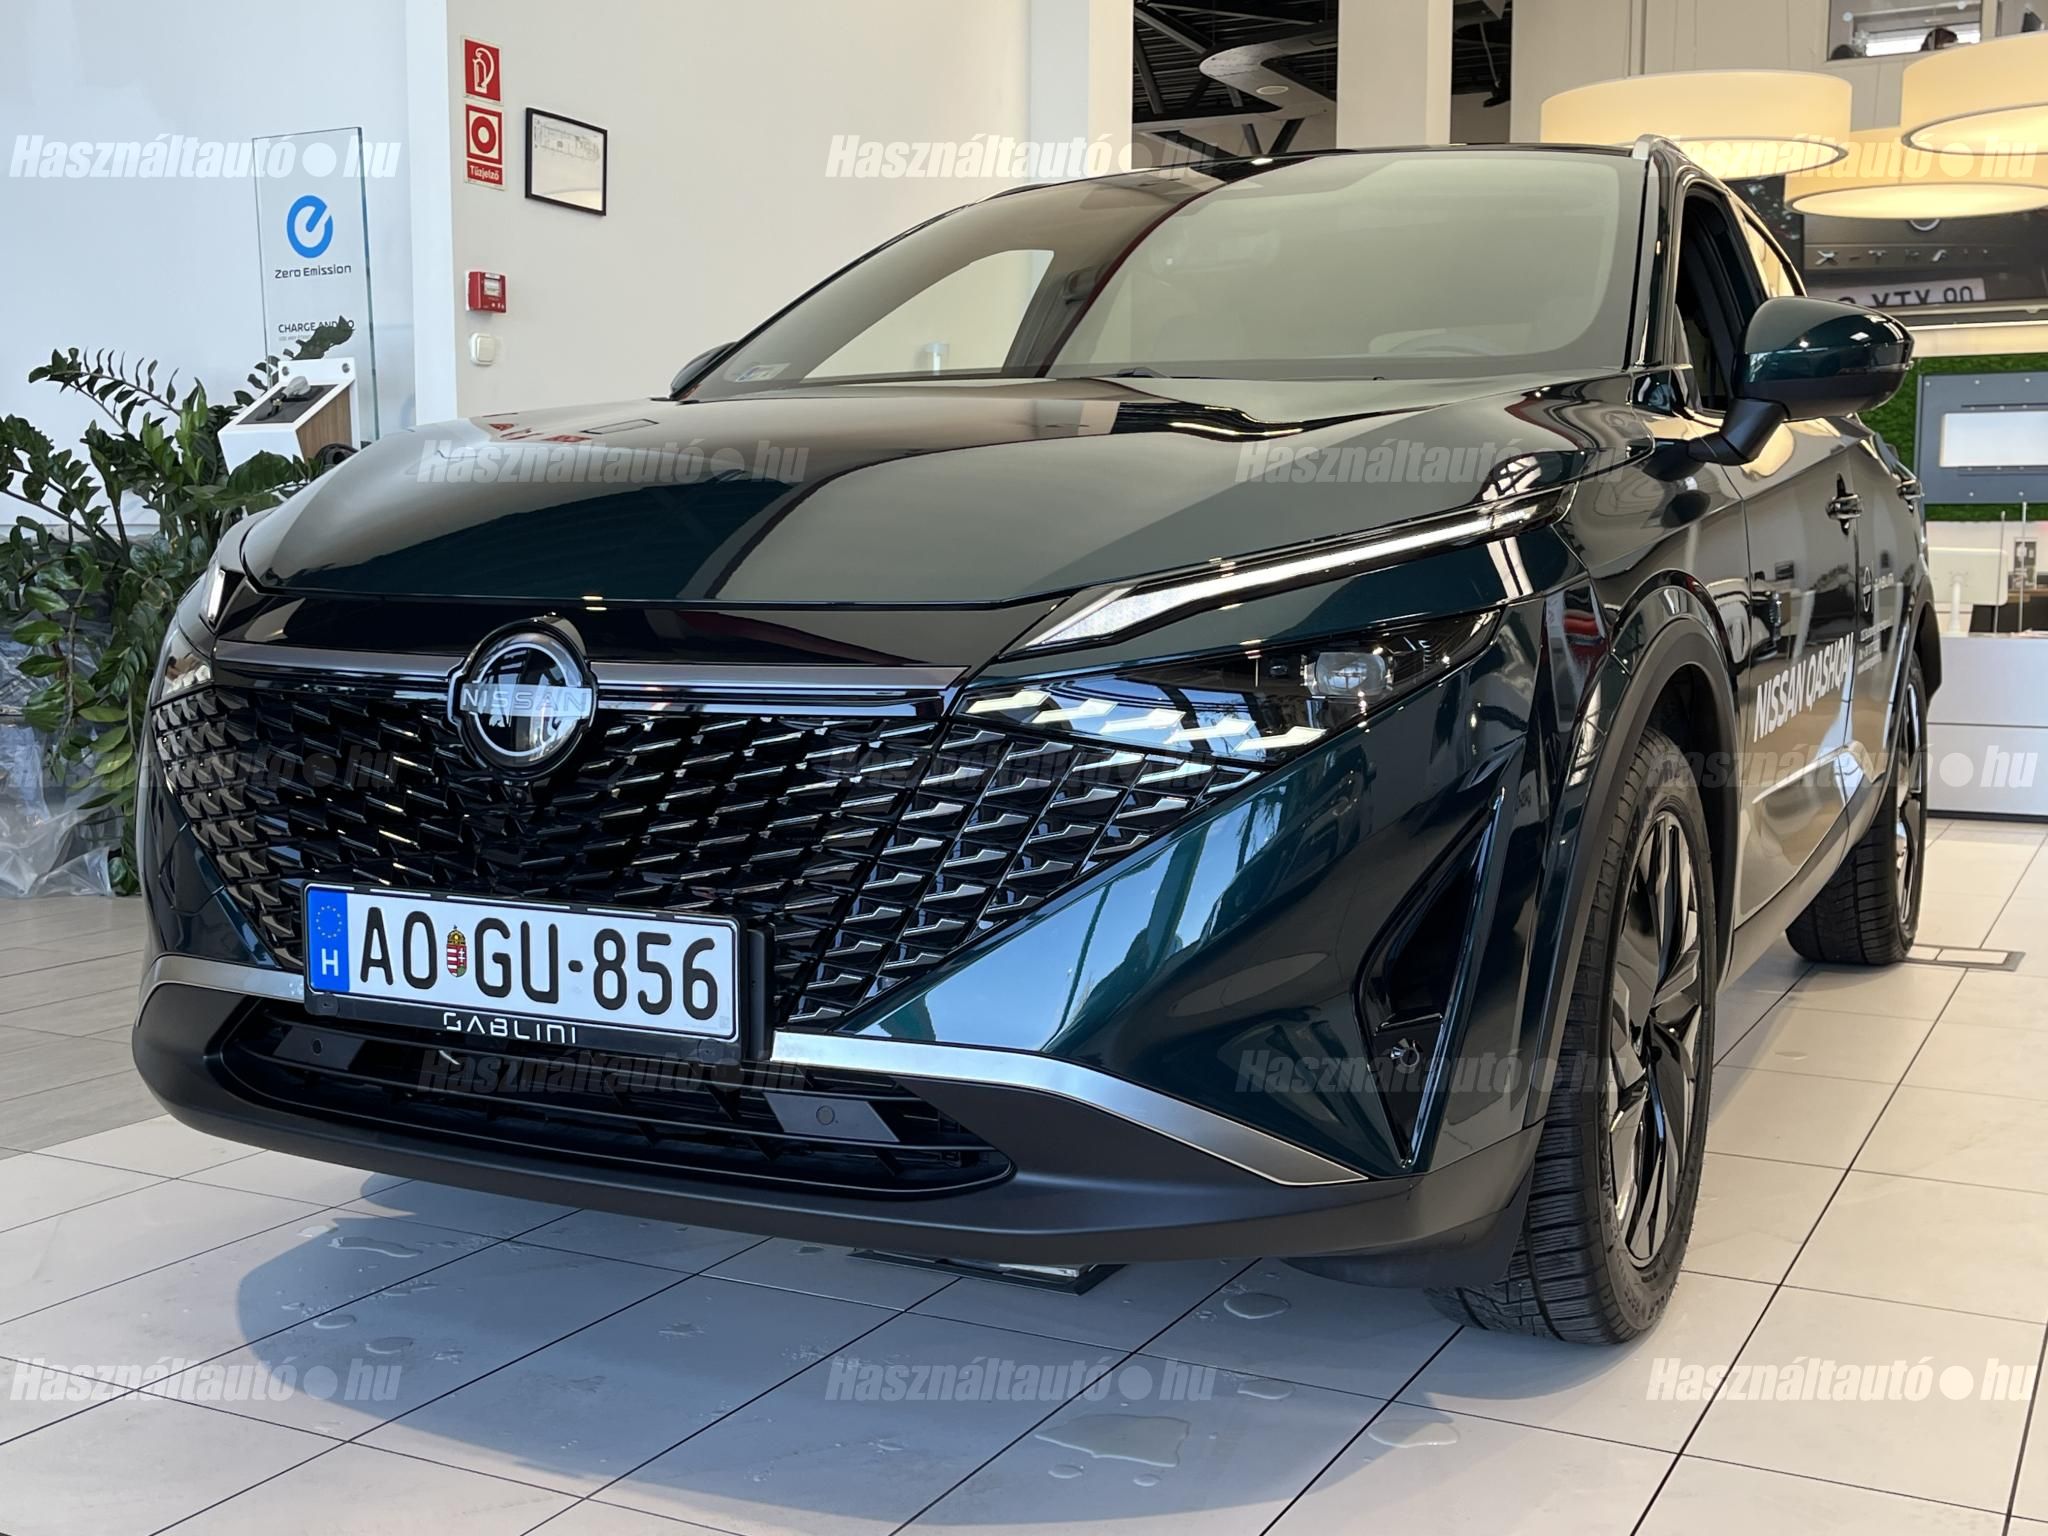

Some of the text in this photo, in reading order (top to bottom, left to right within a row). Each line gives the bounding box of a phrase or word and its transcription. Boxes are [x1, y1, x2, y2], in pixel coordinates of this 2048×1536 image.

[274, 263, 352, 279] Zero Emission
[278, 321, 316, 333] CHARGE
[462, 688, 587, 713] NISSAN
[1753, 659, 1807, 743] NISSAN
[321, 948, 339, 977] H
[443, 1011, 576, 1044] GABLINI
